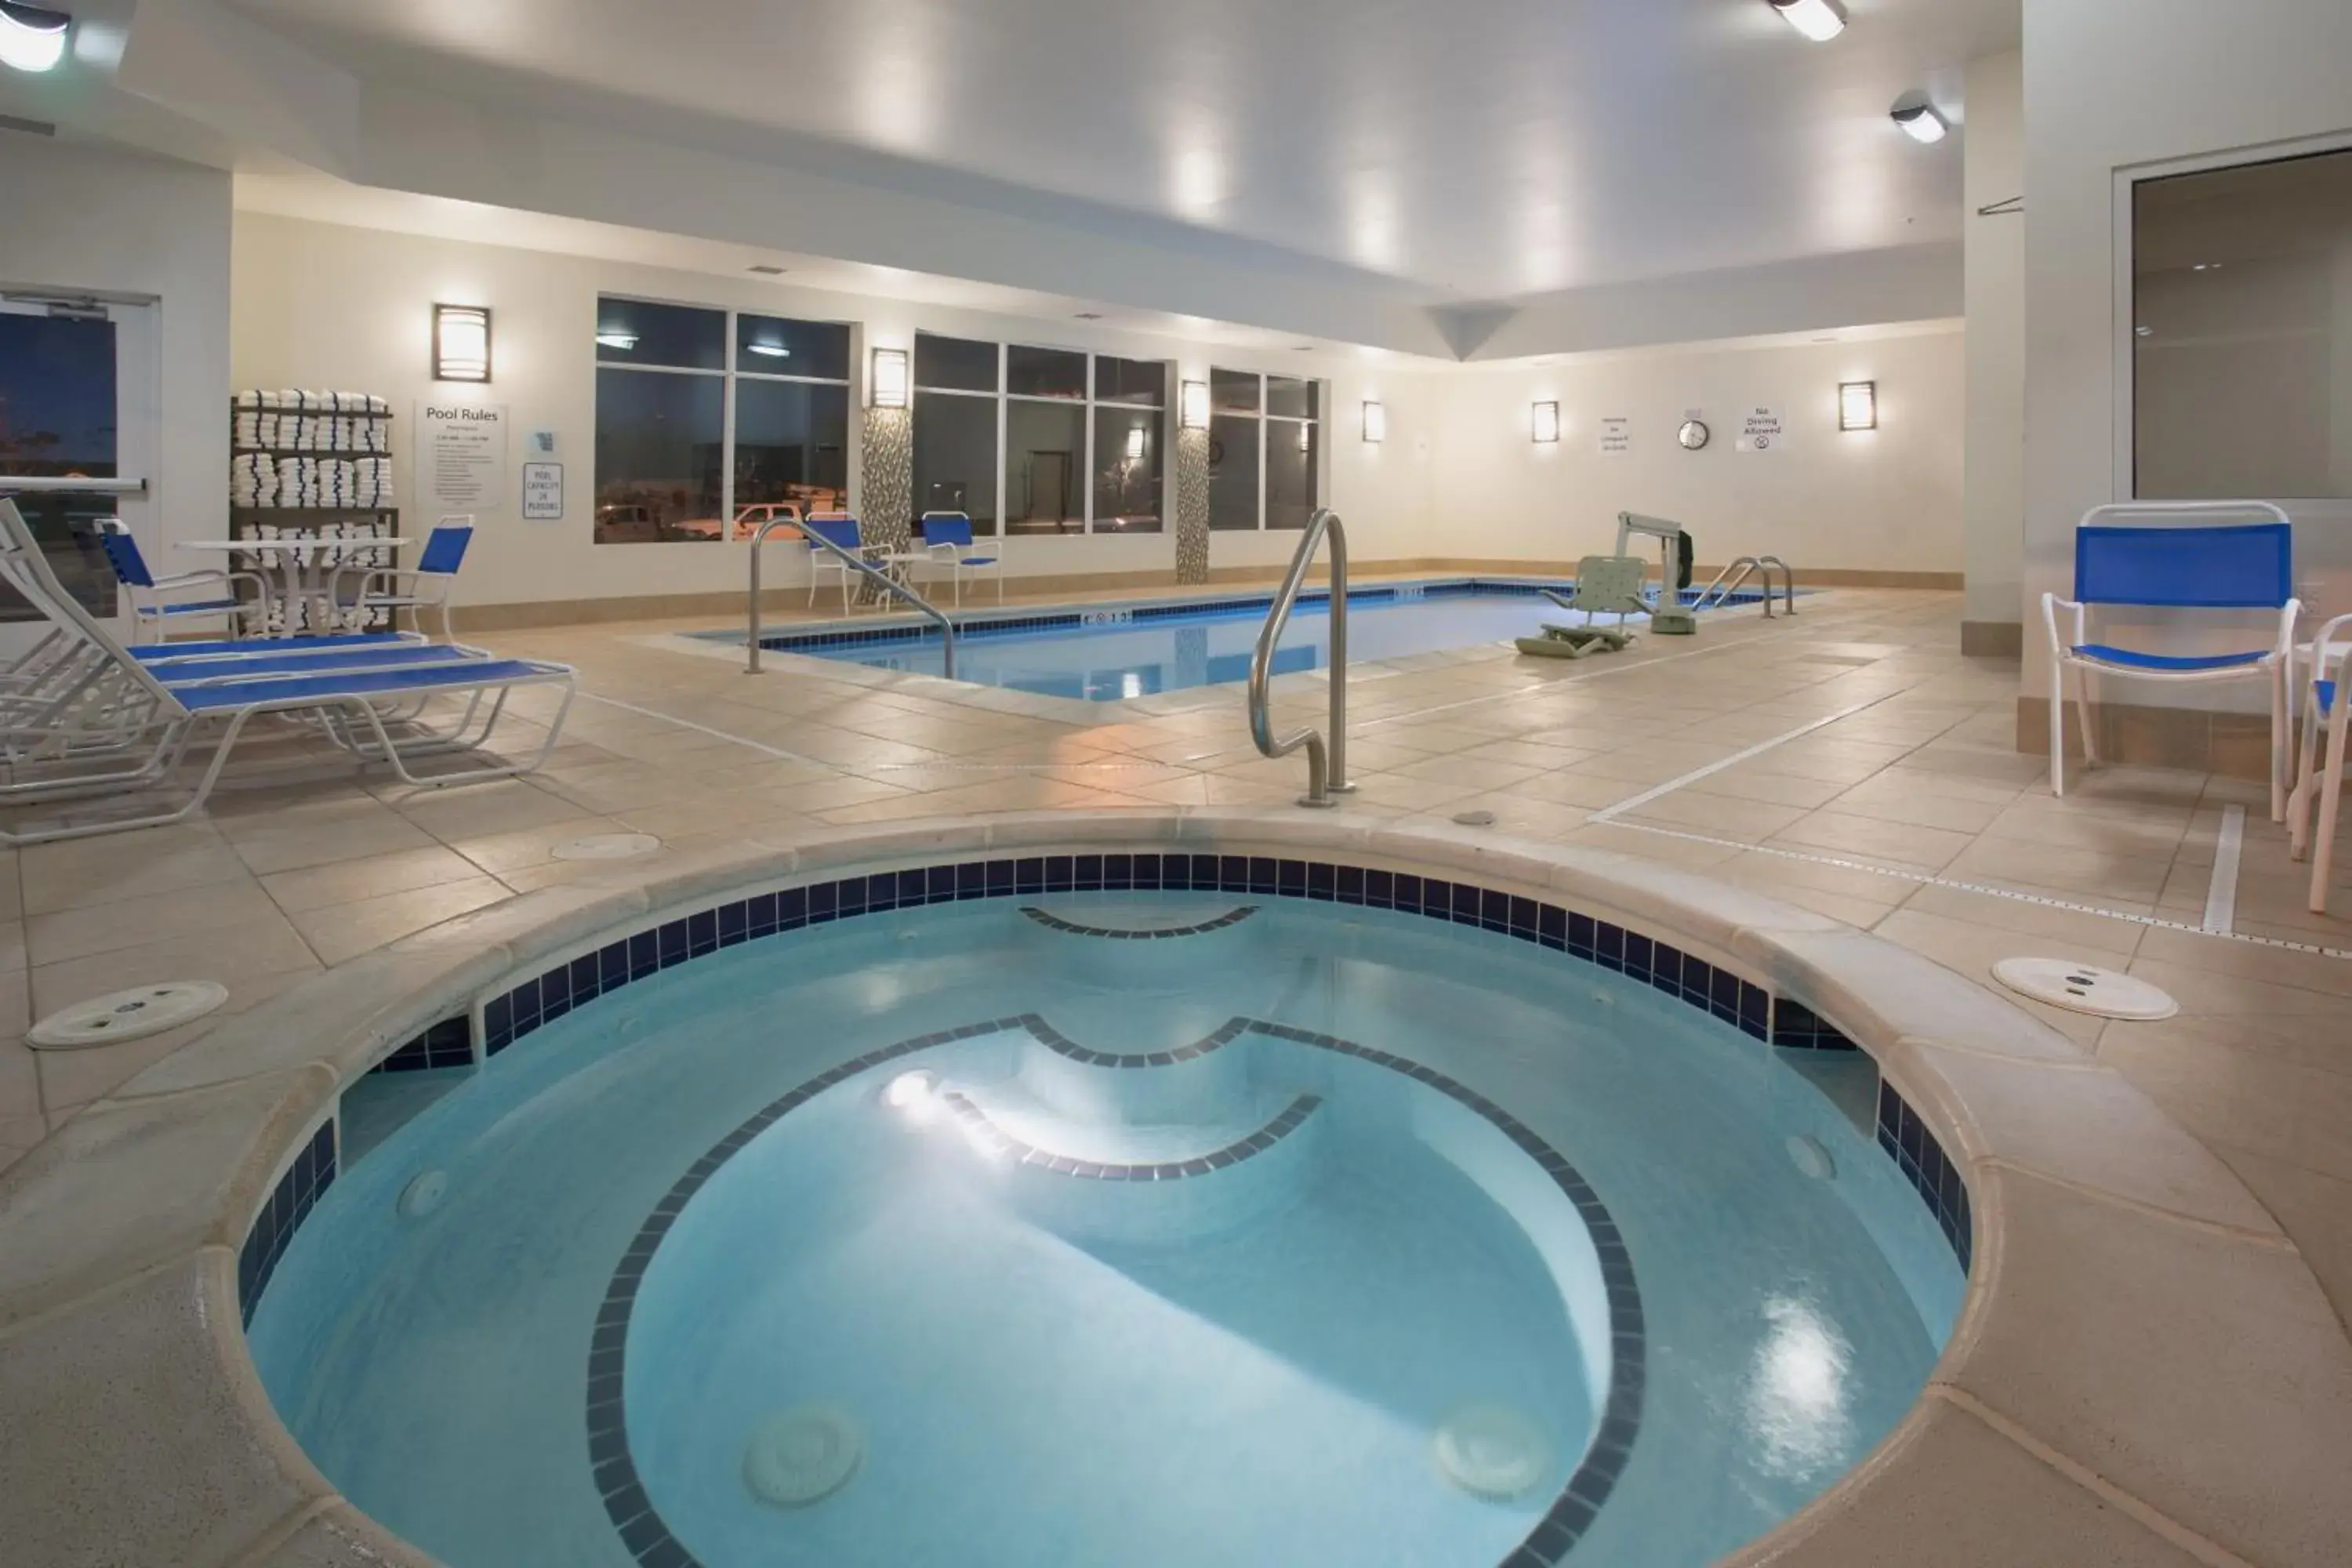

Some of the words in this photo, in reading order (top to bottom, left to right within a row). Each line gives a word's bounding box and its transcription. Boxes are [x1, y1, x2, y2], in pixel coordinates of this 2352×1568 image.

[426, 407, 457, 419] Pool
[462, 408, 498, 421] Rules
[1747, 417, 1777, 426] Diving
[1744, 426, 1781, 435] Allowed
